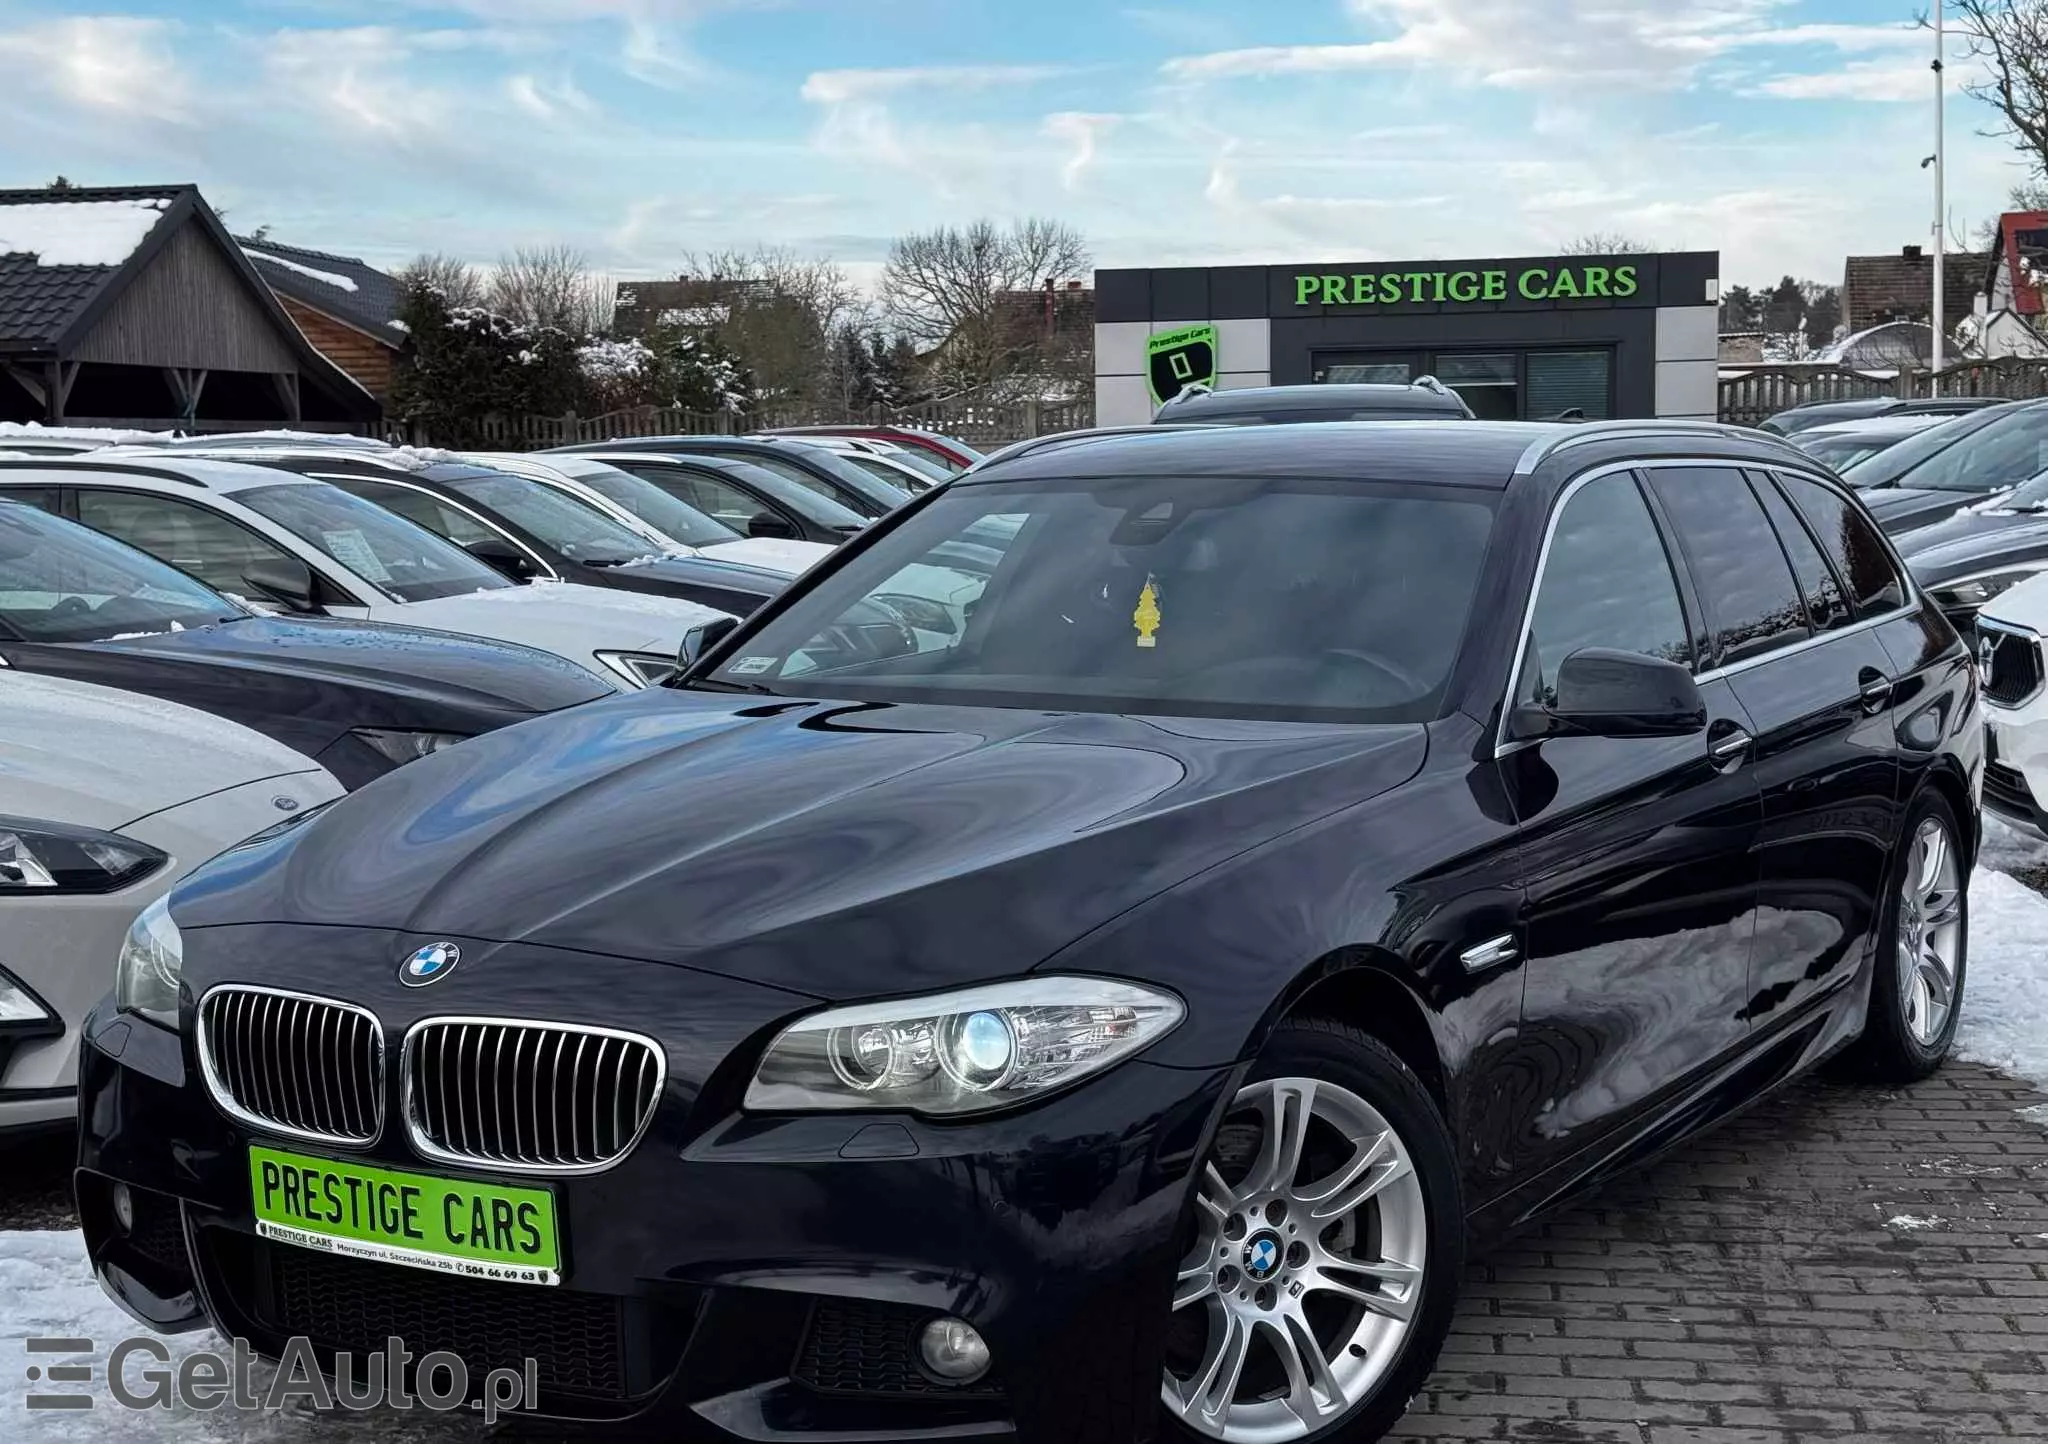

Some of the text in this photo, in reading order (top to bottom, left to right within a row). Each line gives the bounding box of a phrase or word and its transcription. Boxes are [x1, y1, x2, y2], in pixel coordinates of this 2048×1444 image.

[1294, 265, 1638, 306] PRESTIGE CARS
[1149, 327, 1211, 349] Prestige Cars
[262, 1160, 542, 1254] PRESTIGE CARS
[268, 1225, 308, 1243] PRESTIGE
[308, 1236, 333, 1248] CARS
[337, 1243, 377, 1257] Morzyczyn
[378, 1251, 388, 1259] ul.
[438, 1260, 453, 1270] 25b
[465, 1265, 485, 1275] 504
[488, 1268, 501, 1277] 66
[504, 1270, 518, 1279] 69
[521, 1271, 535, 1281] 63
